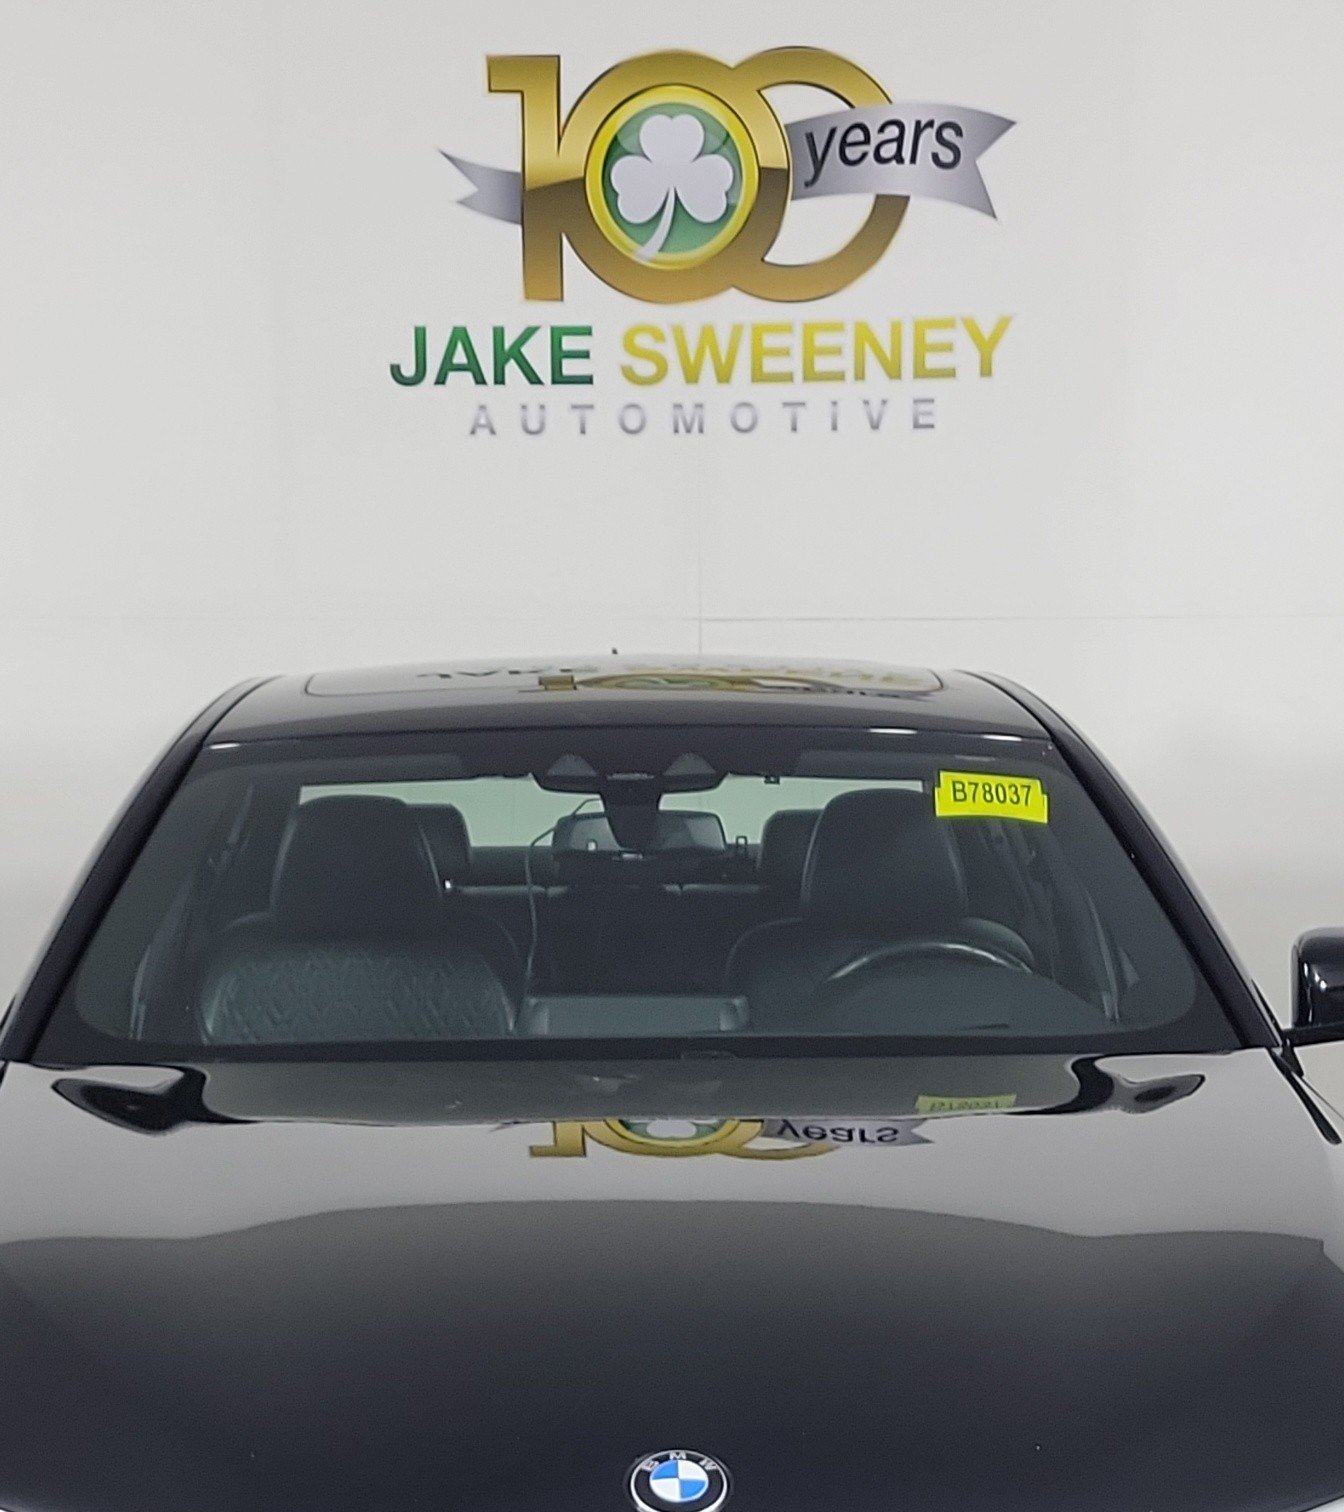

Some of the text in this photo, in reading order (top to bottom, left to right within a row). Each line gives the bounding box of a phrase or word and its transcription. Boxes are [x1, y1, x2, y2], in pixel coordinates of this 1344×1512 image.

[486, 46, 964, 303] 100 years
[389, 315, 1013, 386] JAKE SWEENEY
[469, 398, 937, 437] AUTOMOTIVE
[951, 780, 1032, 807] B78037
[640, 1450, 718, 1472] BMW
